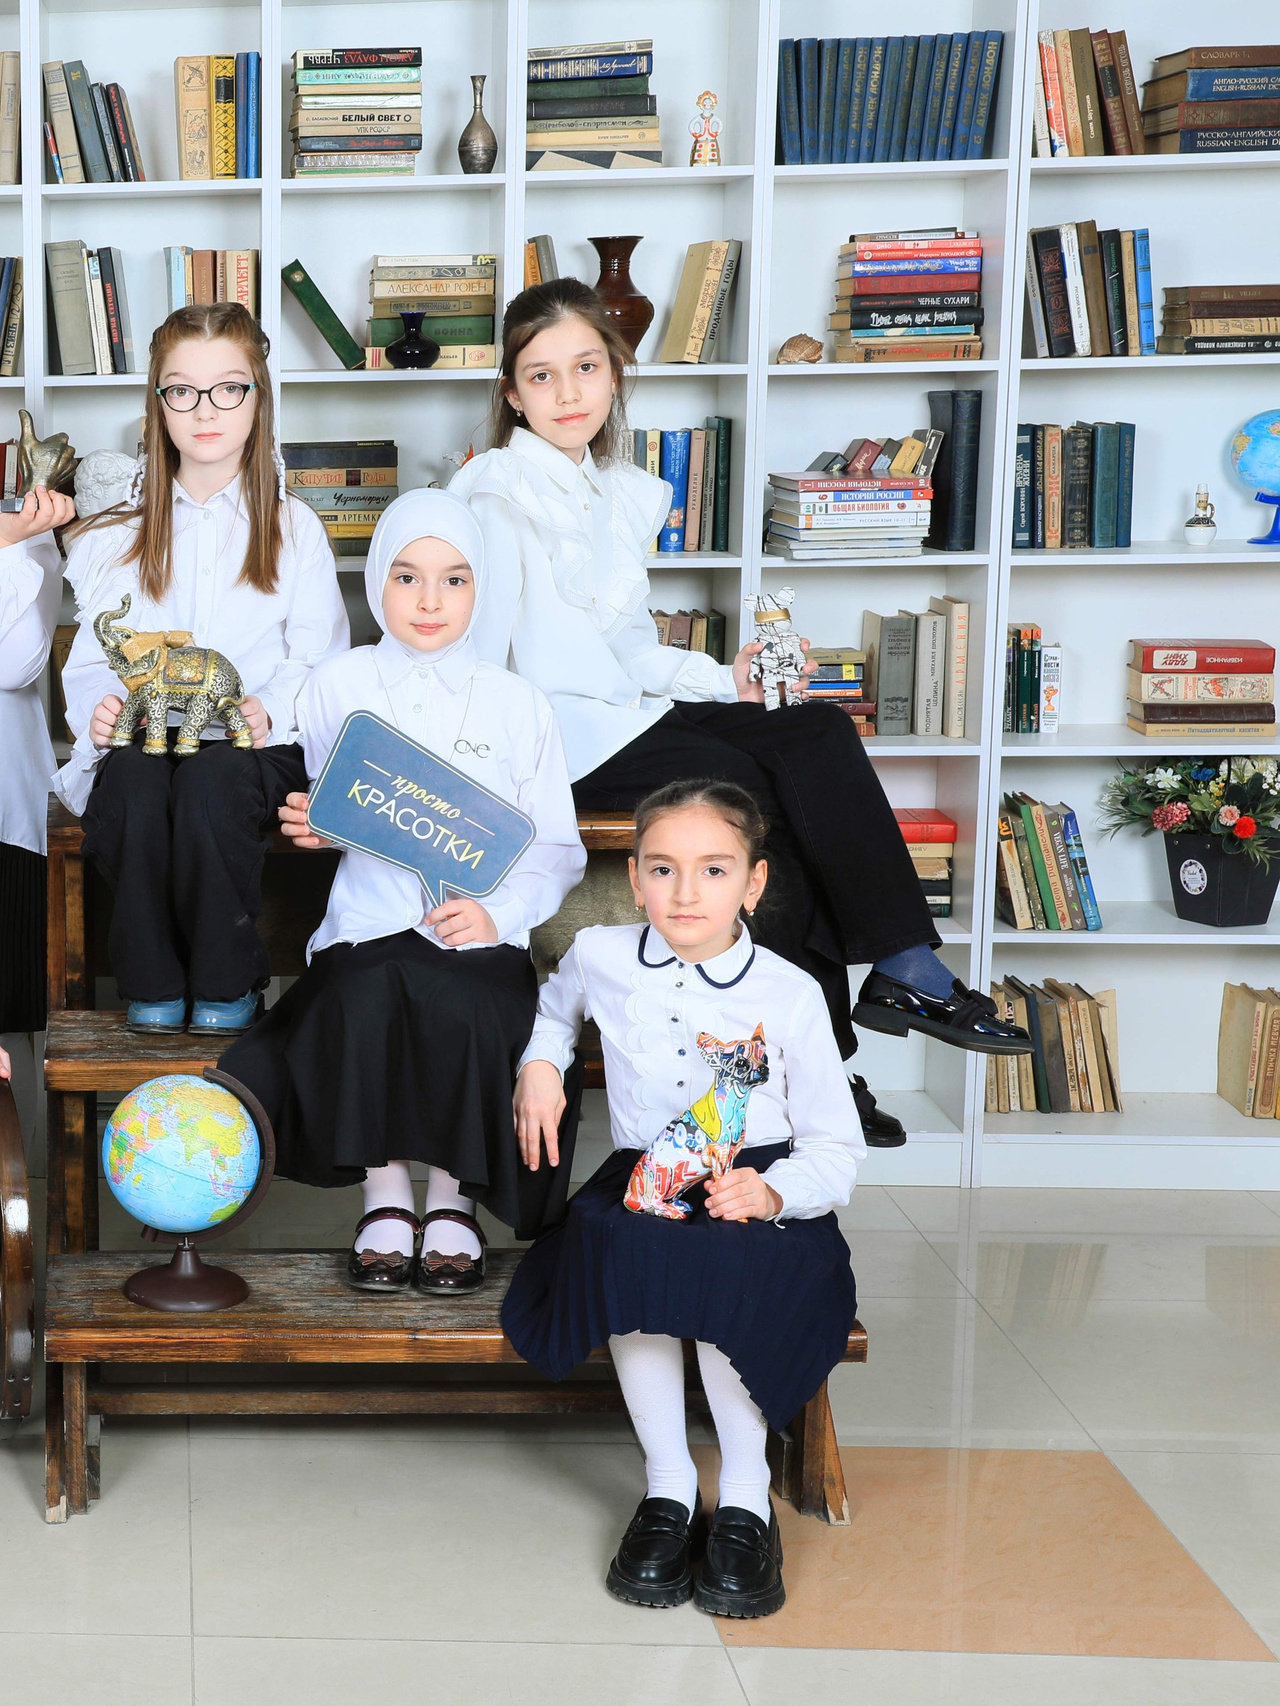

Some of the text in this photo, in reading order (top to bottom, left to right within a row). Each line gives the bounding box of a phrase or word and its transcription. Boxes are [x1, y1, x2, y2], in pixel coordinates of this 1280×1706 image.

[308, 53, 414, 65] ДЖОН ФАУЛЗ ЧЕРВЬ
[1200, 51, 1240, 59] СЛОВАРЬ
[1118, 43, 1134, 95] СКВОЗЬ ОГОНЬ
[975, 41, 999, 128] ДЖЕК ЛОНДОН
[1213, 76, 1268, 85] АНГЛО-РУССКИЙ
[1212, 84, 1266, 92] ENGLISH-RUSSIAN
[342, 113, 375, 122] БЕЛЫЙ
[377, 114, 402, 122] СВЕТ
[369, 126, 391, 134] РСФСР
[1196, 138, 1268, 148] RUSSIAN-ENGLISH
[236, 254, 249, 311] АРЛЕТТ
[387, 284, 451, 294] АЛЕКСАНДР
[708, 259, 735, 341] ПРОДАННЫЕ ГОДЫ
[917, 296, 970, 306] ЧЕРНЫЕ СУХАРИ
[5, 322, 18, 348] ЧЕЙЗ
[434, 327, 473, 336] ВОЙНА
[1016, 453, 1024, 487] ВРЕМЕНА
[1022, 460, 1030, 487] ЖИЗНИ
[361, 472, 387, 485] ГОДЫ
[332, 492, 390, 507] Черноморцы
[841, 491, 905, 500] ИСТОРИЯ РОССИИ
[832, 502, 890, 513] ОБЩАЯ БИОЛОГИЯ
[955, 615, 967, 685] АРМЕНИЯ
[390, 775, 461, 819] просто
[347, 779, 485, 870] КРАСОТКИ
[1053, 831, 1063, 852] VEGAN
[1059, 854, 1069, 870] LIFE
[1266, 1019, 1280, 1077] ПТИЧКА ПЕВЧАЯ
